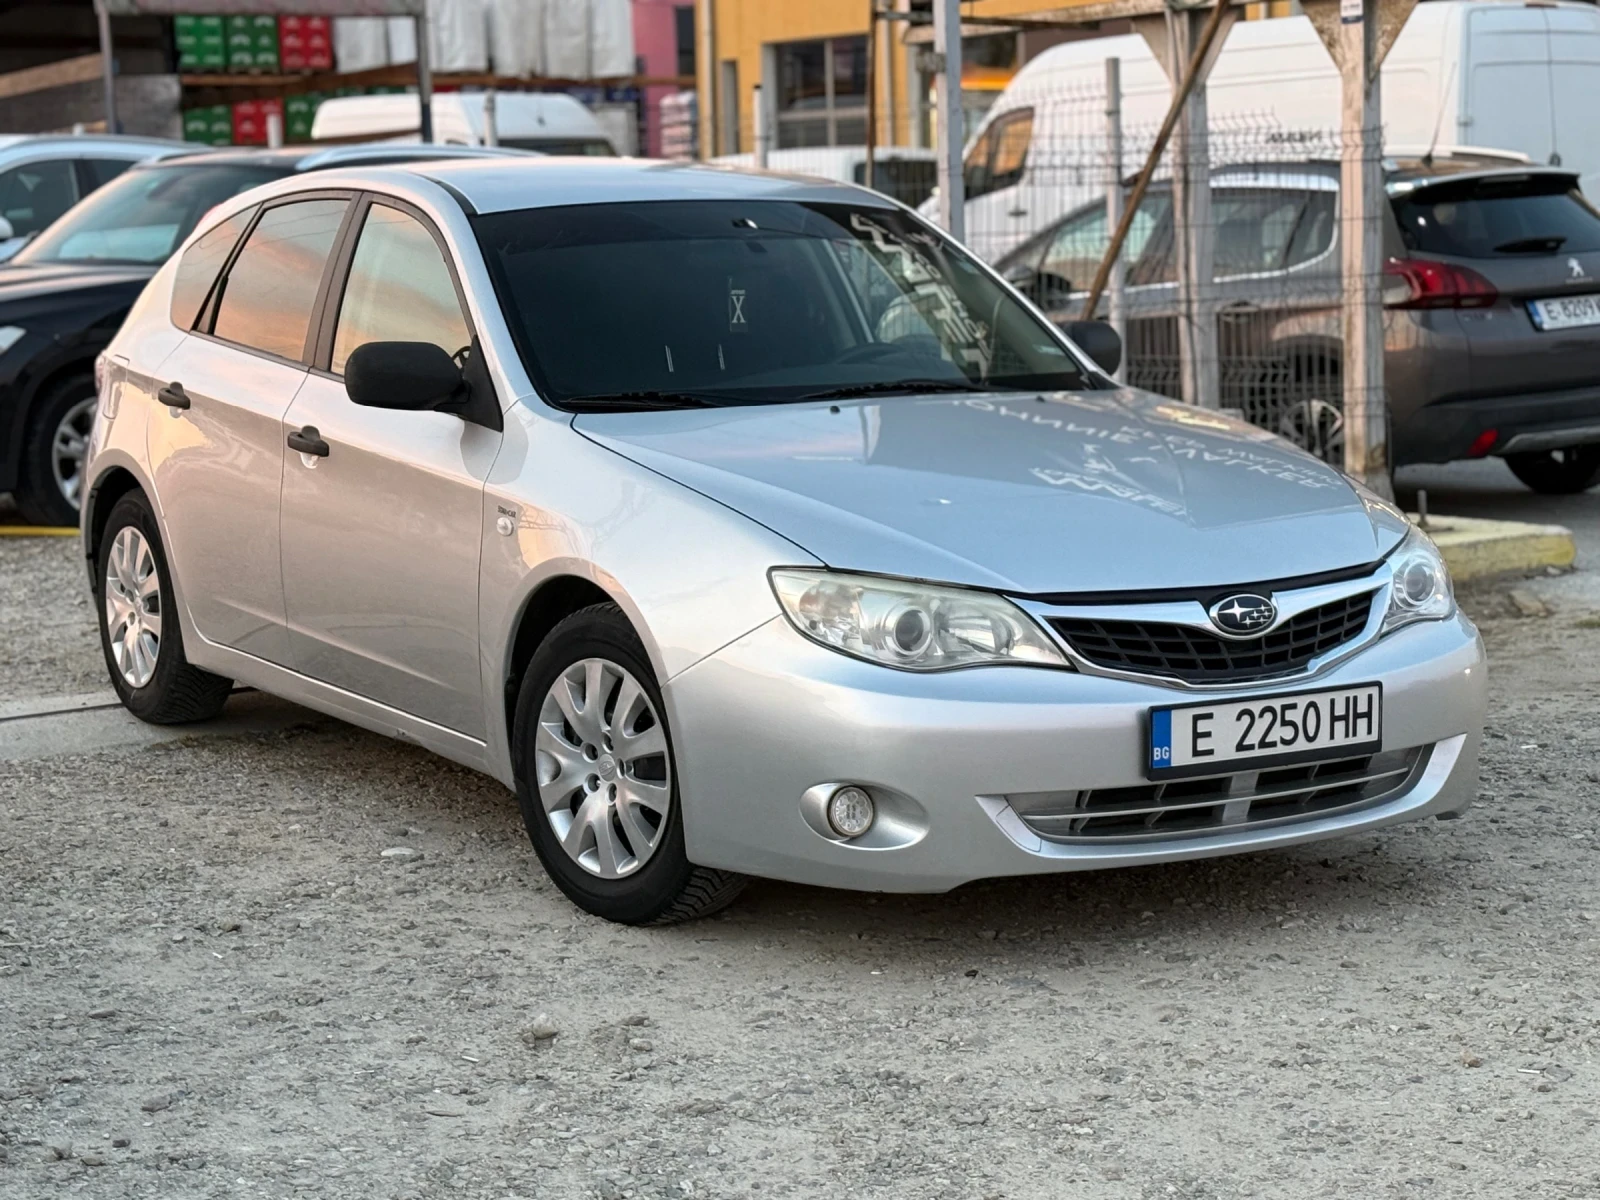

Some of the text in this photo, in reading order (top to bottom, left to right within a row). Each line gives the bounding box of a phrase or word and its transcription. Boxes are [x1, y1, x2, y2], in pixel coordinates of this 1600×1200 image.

[731, 295, 746, 323] X
[1543, 301, 1558, 320] E
[1192, 693, 1373, 757] E 2250 HH
[1153, 746, 1170, 761] BG
